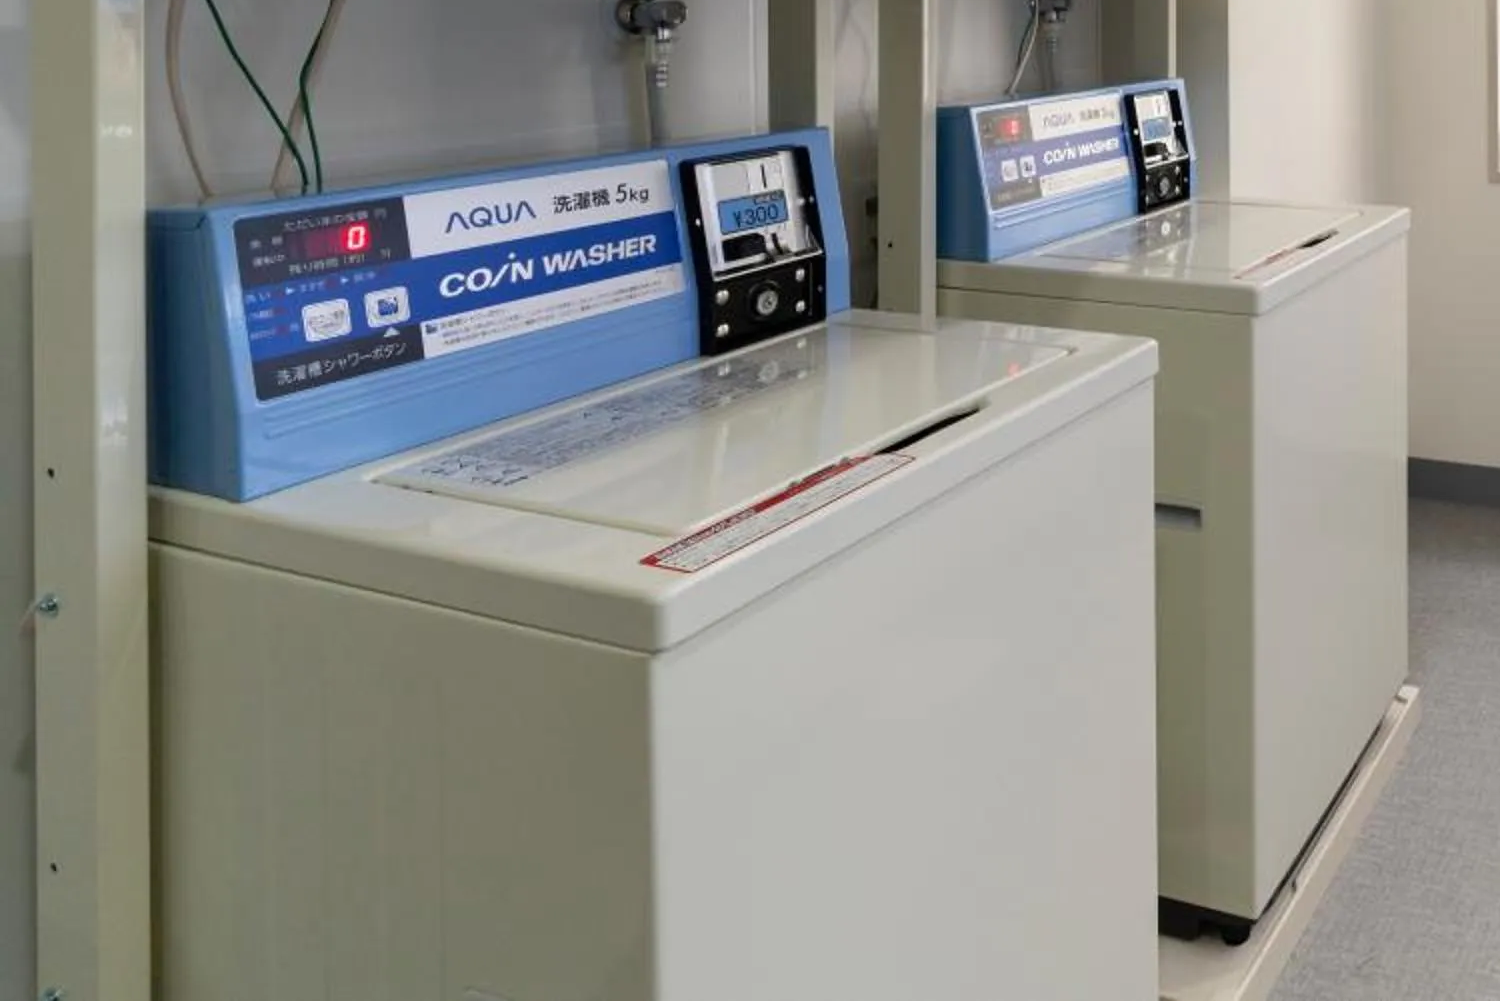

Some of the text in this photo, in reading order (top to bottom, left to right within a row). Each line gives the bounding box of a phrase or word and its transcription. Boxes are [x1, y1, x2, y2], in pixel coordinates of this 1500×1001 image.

[445, 203, 537, 234] AQUA
[615, 183, 650, 205] 5kg
[733, 203, 779, 228] ¥300
[347, 225, 367, 250] 0
[440, 235, 657, 297] COIN WASHER
